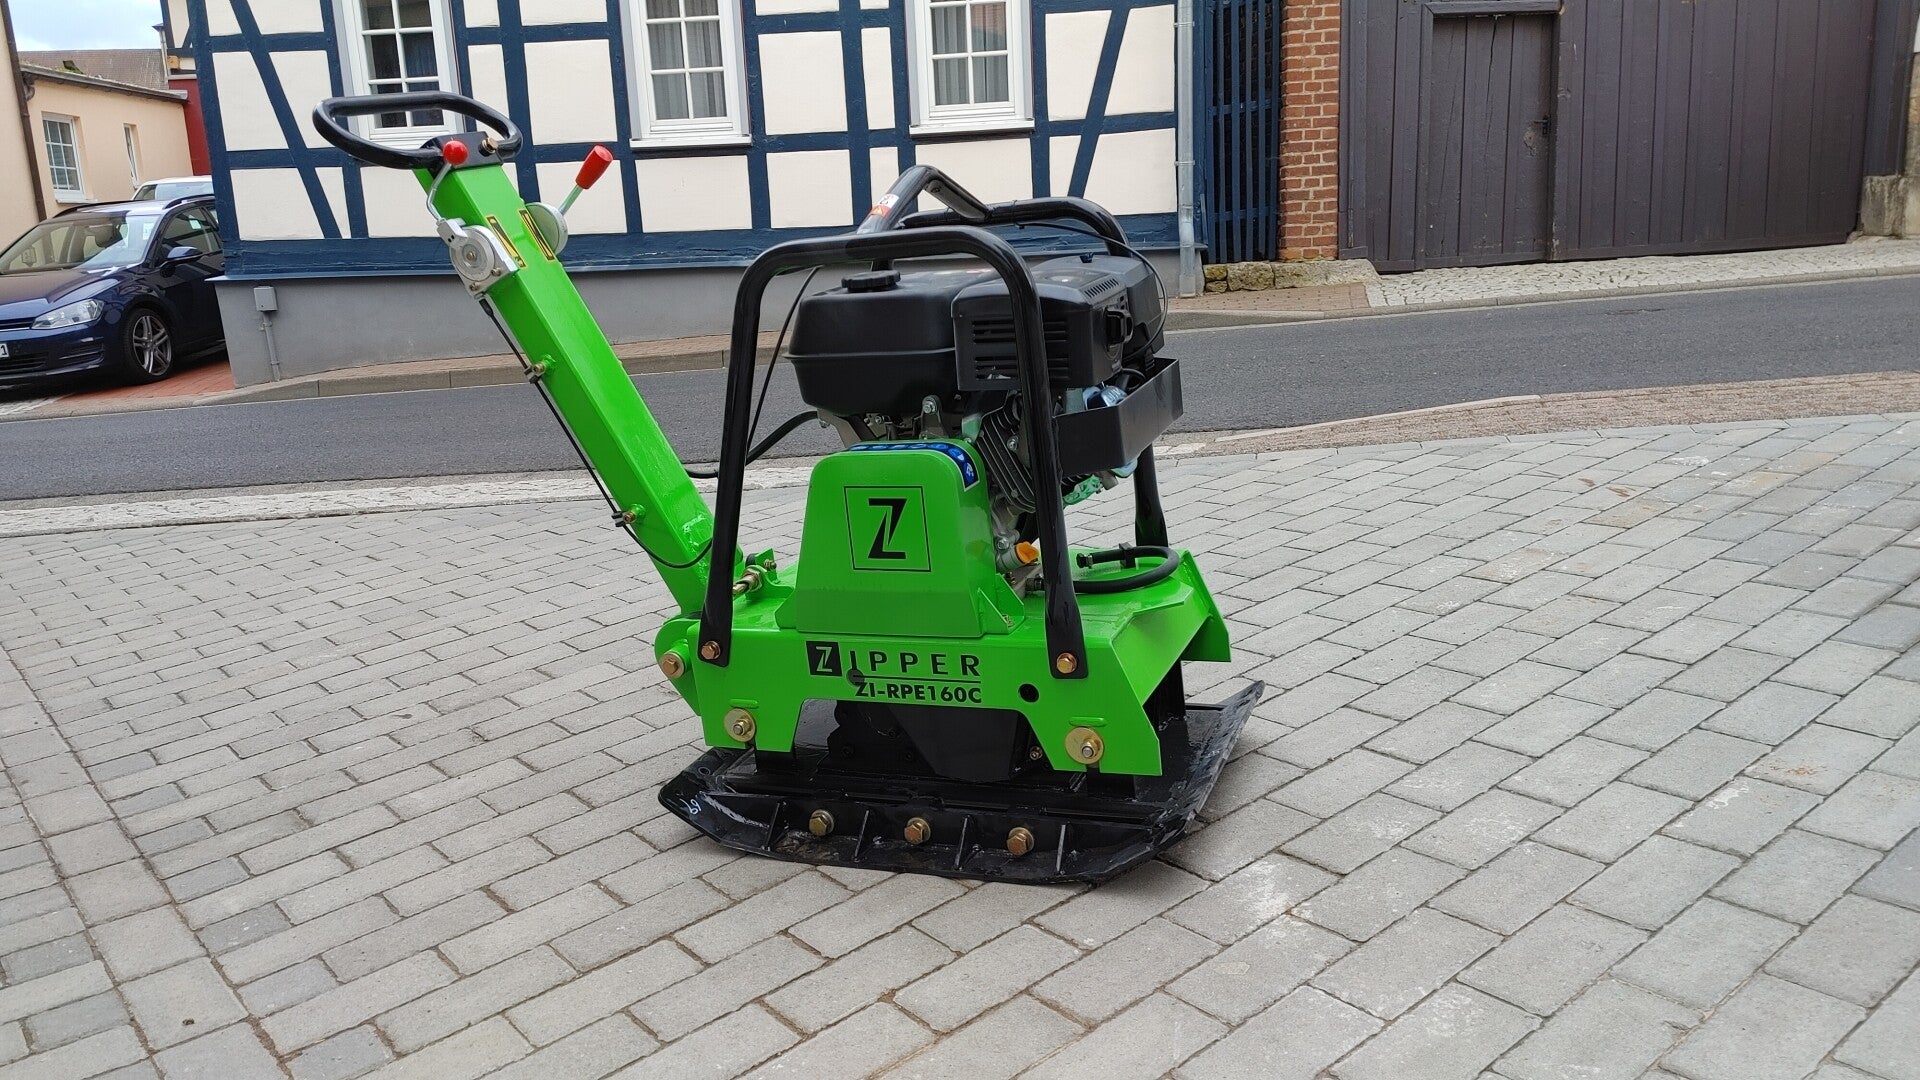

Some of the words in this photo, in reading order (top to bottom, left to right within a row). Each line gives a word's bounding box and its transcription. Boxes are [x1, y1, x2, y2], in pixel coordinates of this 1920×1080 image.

[868, 497, 908, 560] Z
[806, 641, 981, 677] ZIPPER
[855, 682, 982, 703] ZI-RPE160C
